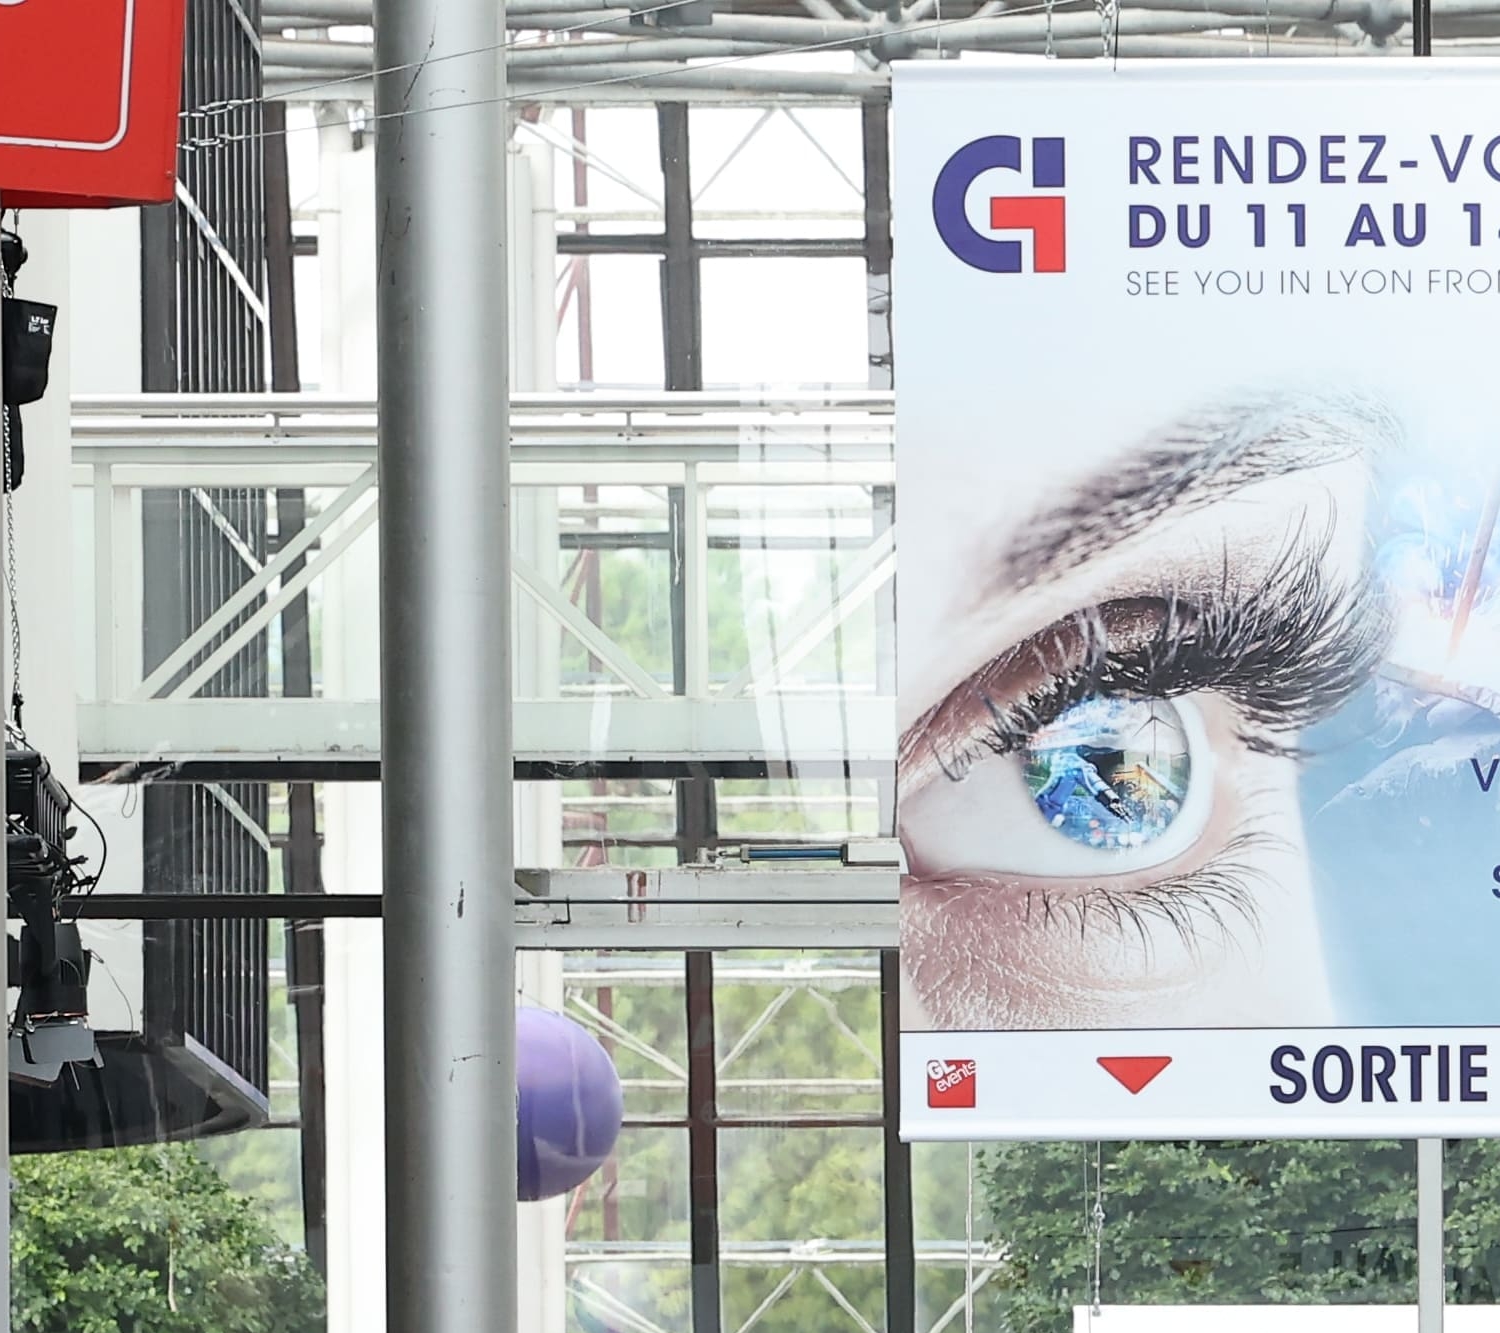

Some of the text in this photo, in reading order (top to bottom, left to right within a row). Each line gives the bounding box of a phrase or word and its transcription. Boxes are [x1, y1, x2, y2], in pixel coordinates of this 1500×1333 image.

[1128, 203, 1211, 249] DU
[1250, 204, 1309, 248] 11
[1347, 204, 1426, 248] AU
[1127, 270, 1185, 297] SEE
[1195, 270, 1267, 297] YOU
[1279, 270, 1313, 296] IN
[1326, 269, 1414, 296] LYON
[1269, 1045, 1489, 1104] SORTIE
